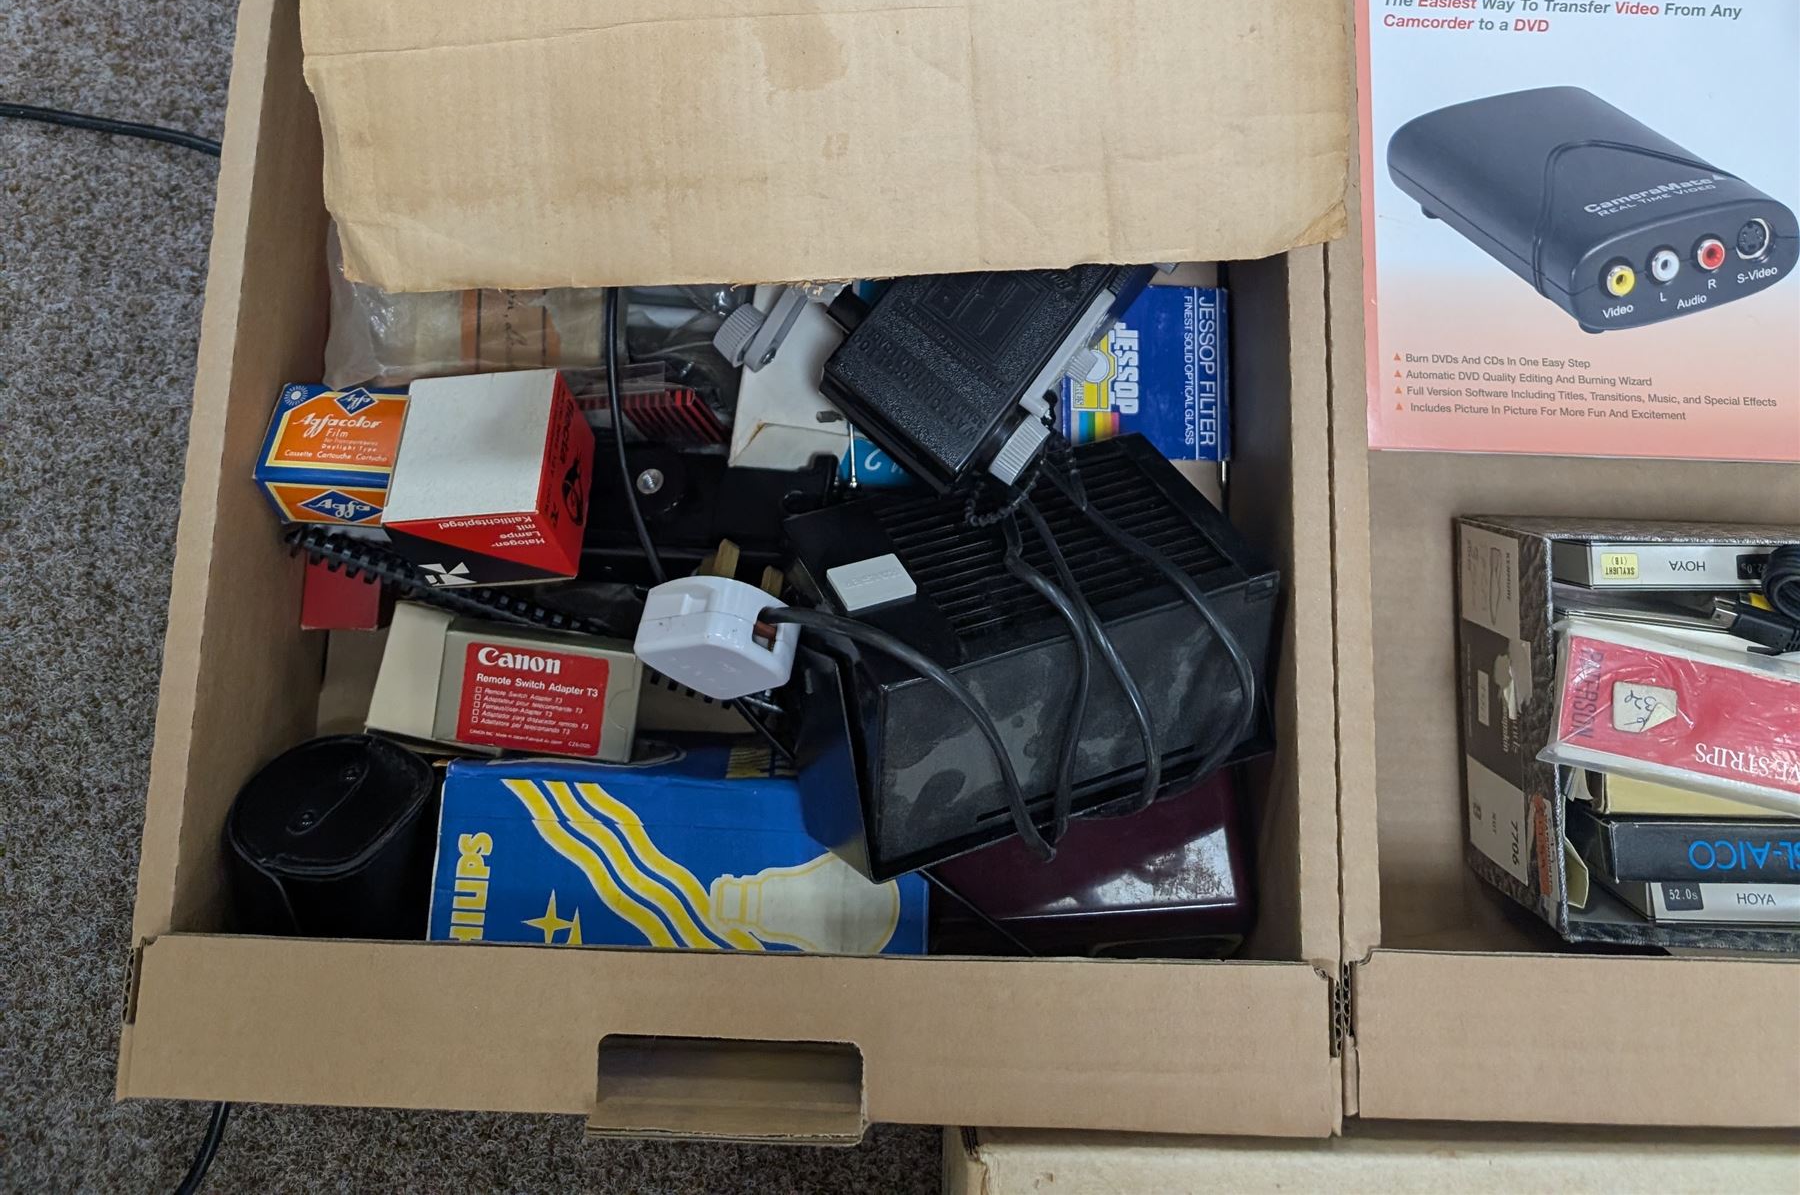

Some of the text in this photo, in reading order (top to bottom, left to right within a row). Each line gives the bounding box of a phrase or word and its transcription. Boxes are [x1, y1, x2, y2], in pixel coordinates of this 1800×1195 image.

[1615, 1, 1660, 15] Video
[1664, 3, 1706, 17] From
[1710, 4, 1742, 20] Any
[1383, 14, 1549, 32] Camcorder to a DVD
[1584, 177, 1713, 213] CameraMate
[1598, 185, 1716, 217] REAL TIME VIDEO
[1736, 266, 1778, 283] S-Video
[1708, 278, 1717, 289] R
[1660, 292, 1667, 302] L
[1677, 294, 1707, 310] Audio
[1602, 304, 1634, 318] Video
[1110, 322, 1139, 414] JESSOP
[1405, 354, 1591, 369] Burn DVDs And CDs In One Easy Step
[1184, 296, 1194, 445] FINEST SOLID OPTICAL GLASS
[1199, 296, 1216, 445] JESSOP FILTER
[1406, 370, 1653, 387] Automatic DVD Quality Editing And Burning Wizard
[340, 394, 370, 409] Agfa
[1407, 386, 1777, 407] Full Version Software Including Titles, Transitions, Music, and Special Effects
[1410, 403, 1686, 420] Includes Picture In Picture For More Fun And Excitement
[293, 412, 382, 438] Agfacolor
[326, 428, 348, 437] Film
[285, 449, 312, 457] Cassette
[356, 453, 387, 462] Cartucho
[308, 499, 371, 518] Agfa
[439, 515, 532, 530] Kaltlichtspiegel
[491, 538, 545, 547] Halogen-
[499, 530, 541, 539] Lampe
[1605, 567, 1635, 576] SKYLIGHT
[1669, 560, 1706, 571] HOYA
[478, 647, 561, 674] Canon
[476, 673, 598, 697] Remote Switch Adapter T3
[1695, 742, 1769, 777] STRIPS
[1669, 888, 1698, 900] 52.0s
[1737, 893, 1776, 905] HOYA
